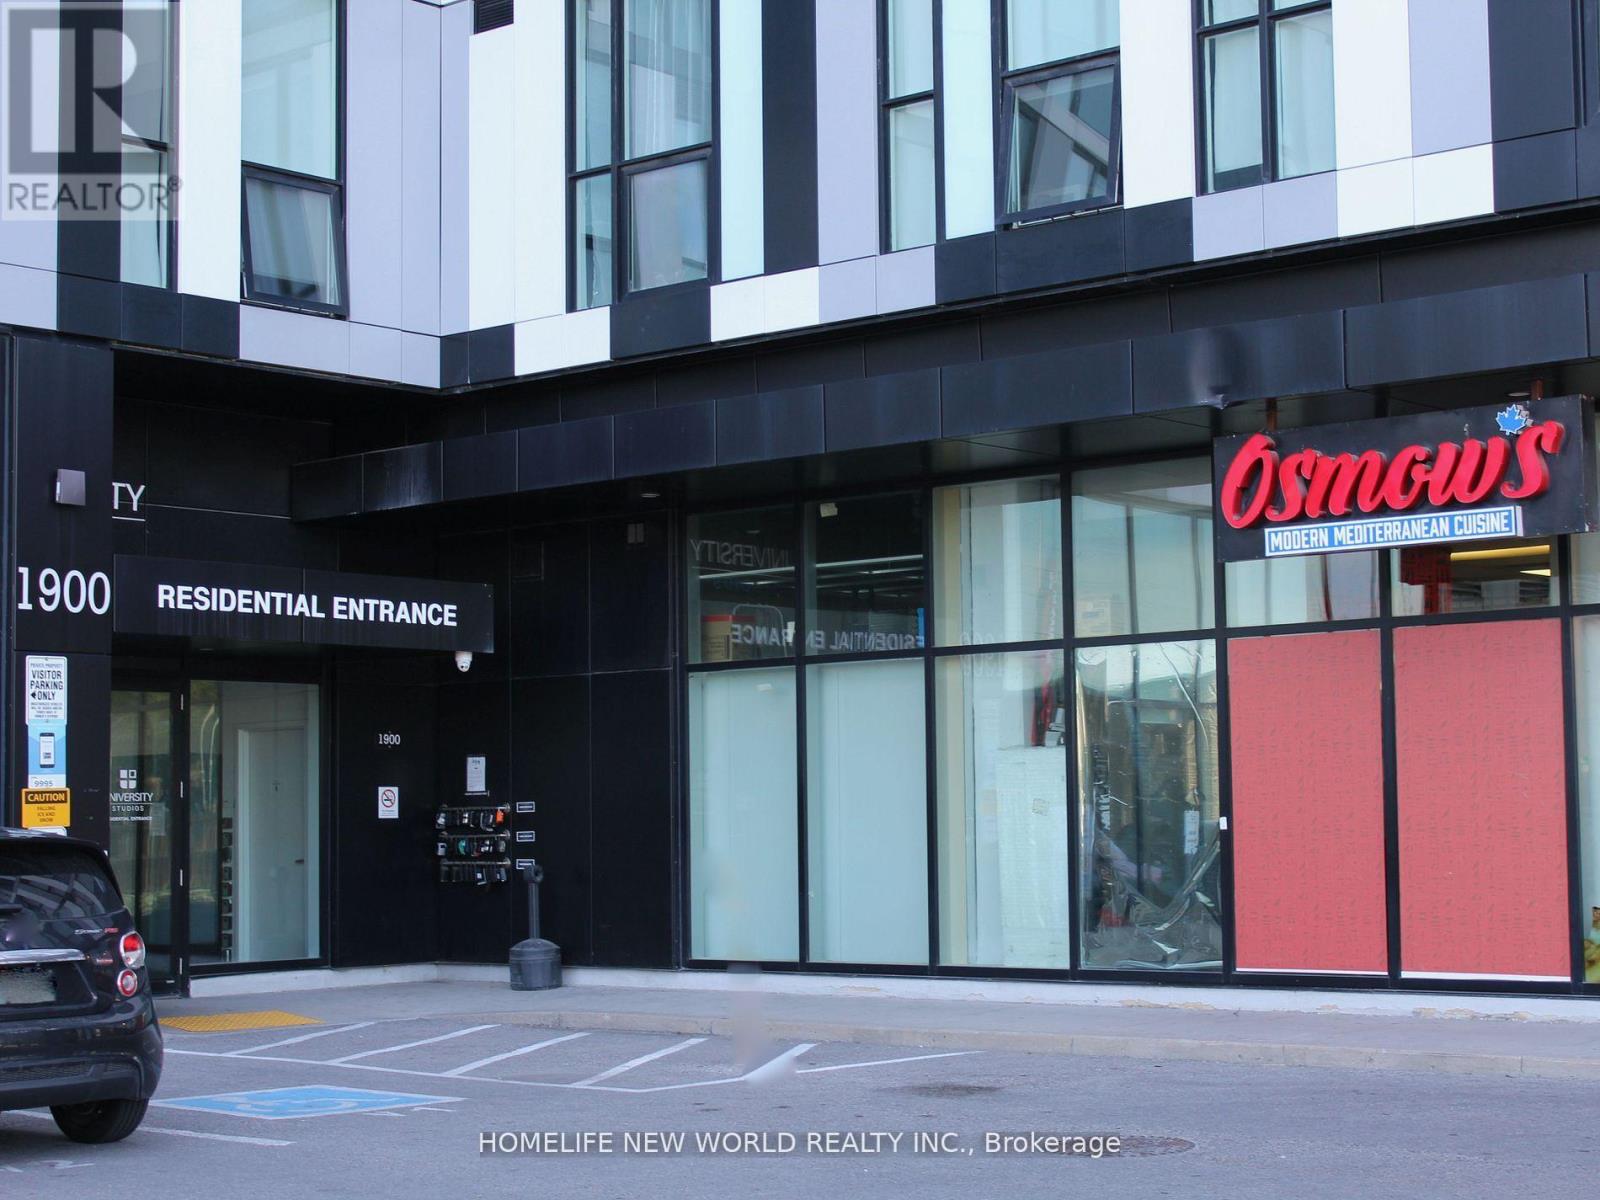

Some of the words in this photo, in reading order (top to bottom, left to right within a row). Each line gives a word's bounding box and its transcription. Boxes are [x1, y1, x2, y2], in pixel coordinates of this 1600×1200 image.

[1270, 527, 1329, 550] MODERN
[1333, 517, 1449, 544] MEDITERRANEAN
[1454, 510, 1510, 534] CUISINE
[17, 566, 111, 615] 1900
[157, 584, 326, 619] RESIDENTIAL
[332, 596, 458, 627] ENTRANCE
[31, 670, 62, 680] VISITOR
[30, 681, 64, 690] PARKING
[37, 691, 56, 701] ONLY
[378, 733, 401, 745] 1900
[27, 793, 65, 802] CAUTION
